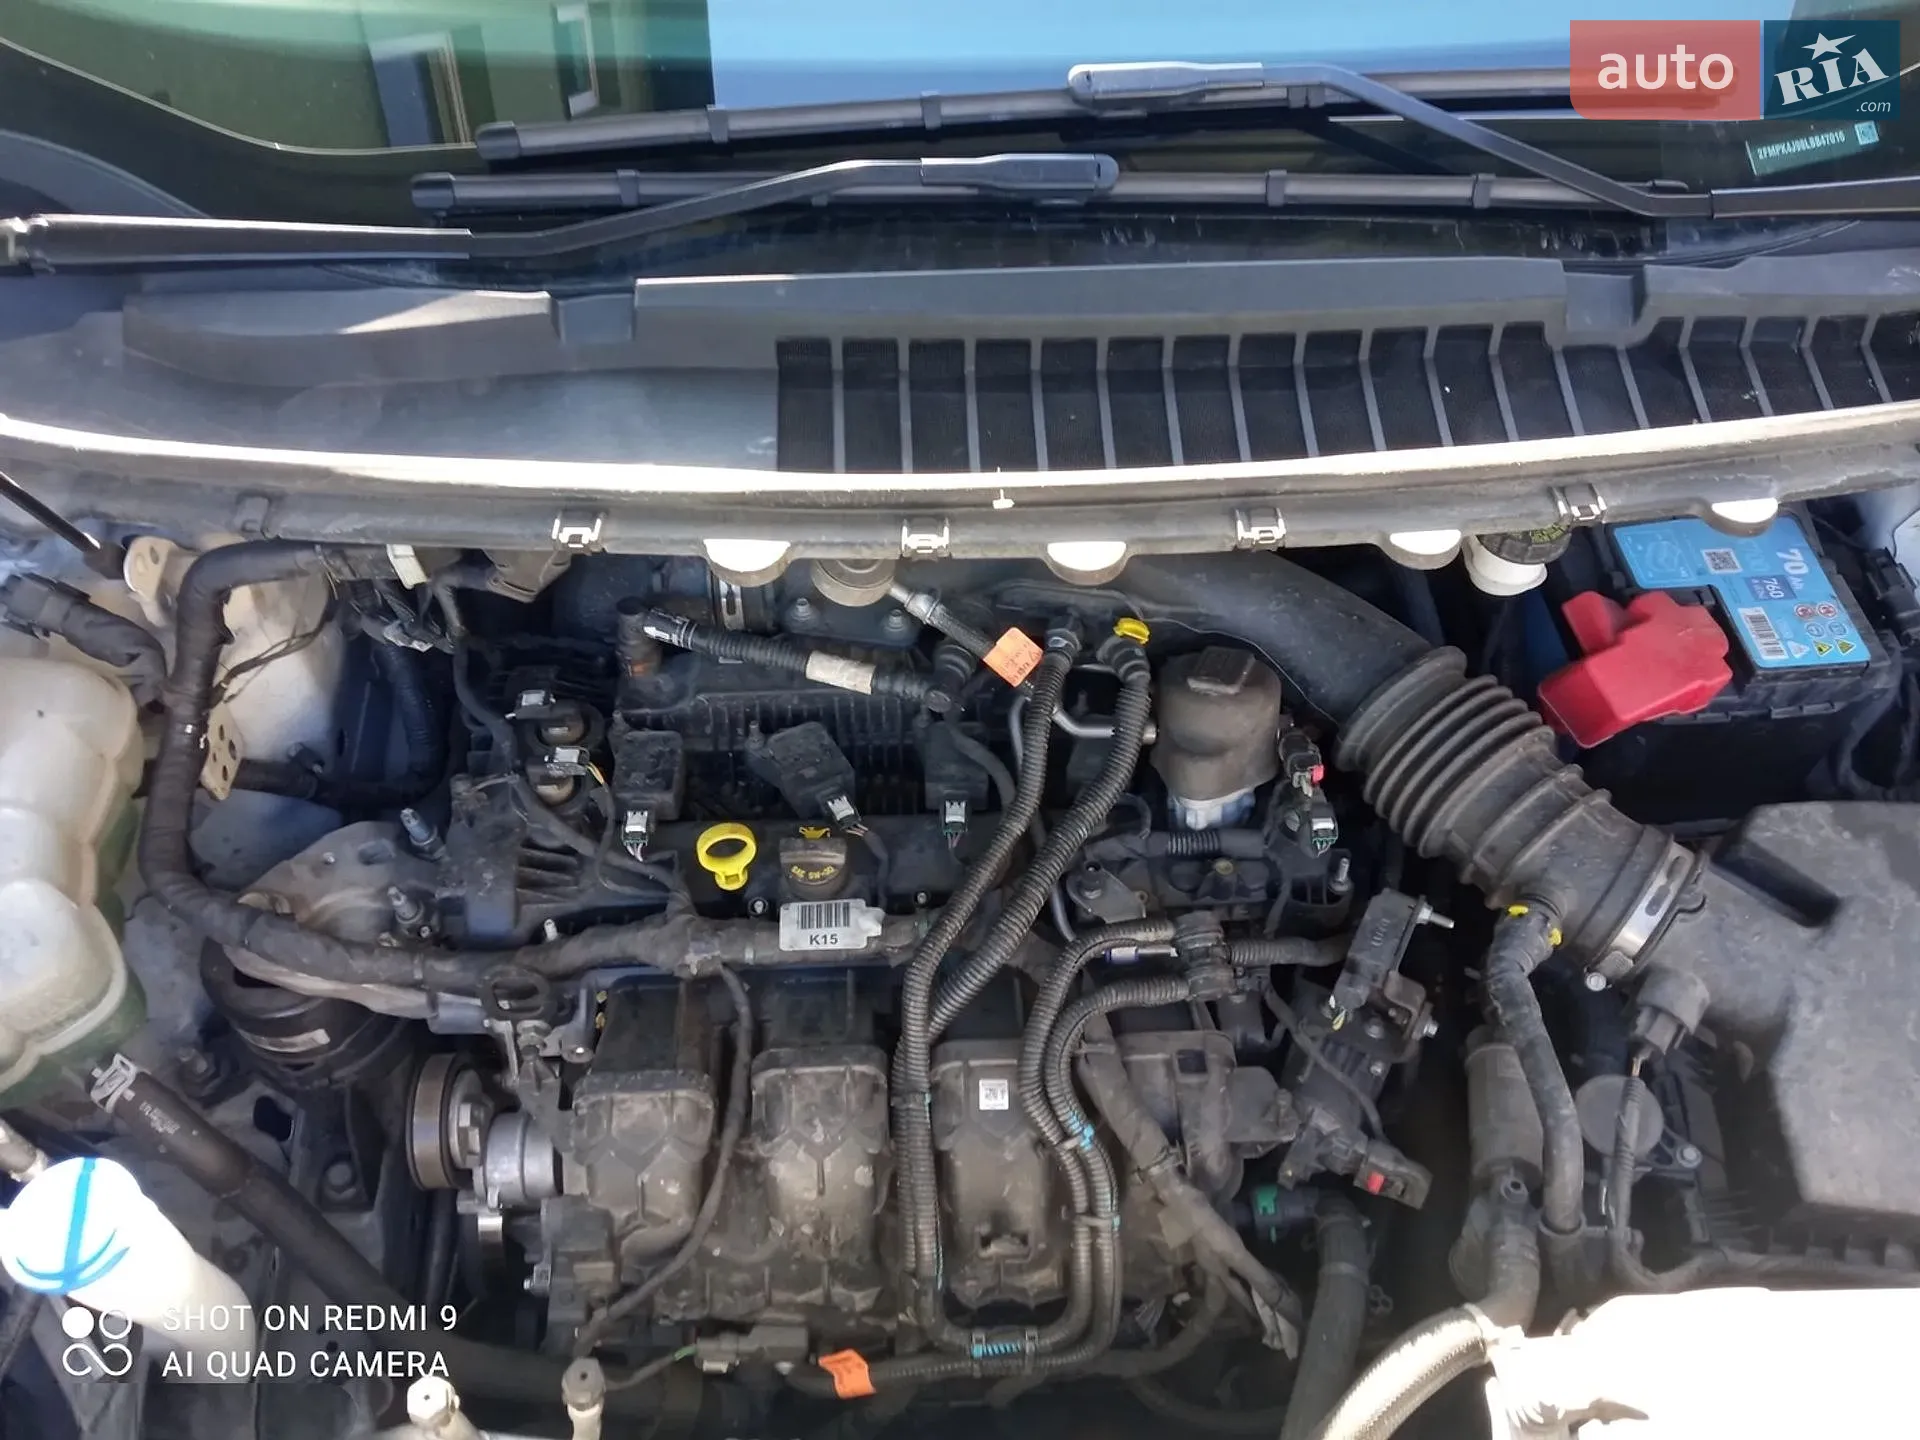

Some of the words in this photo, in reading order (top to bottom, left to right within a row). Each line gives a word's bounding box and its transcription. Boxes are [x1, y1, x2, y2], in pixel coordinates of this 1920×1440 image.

[1776, 548, 1809, 574] 70
[1763, 578, 1785, 598] 760
[809, 934, 839, 946] K15
